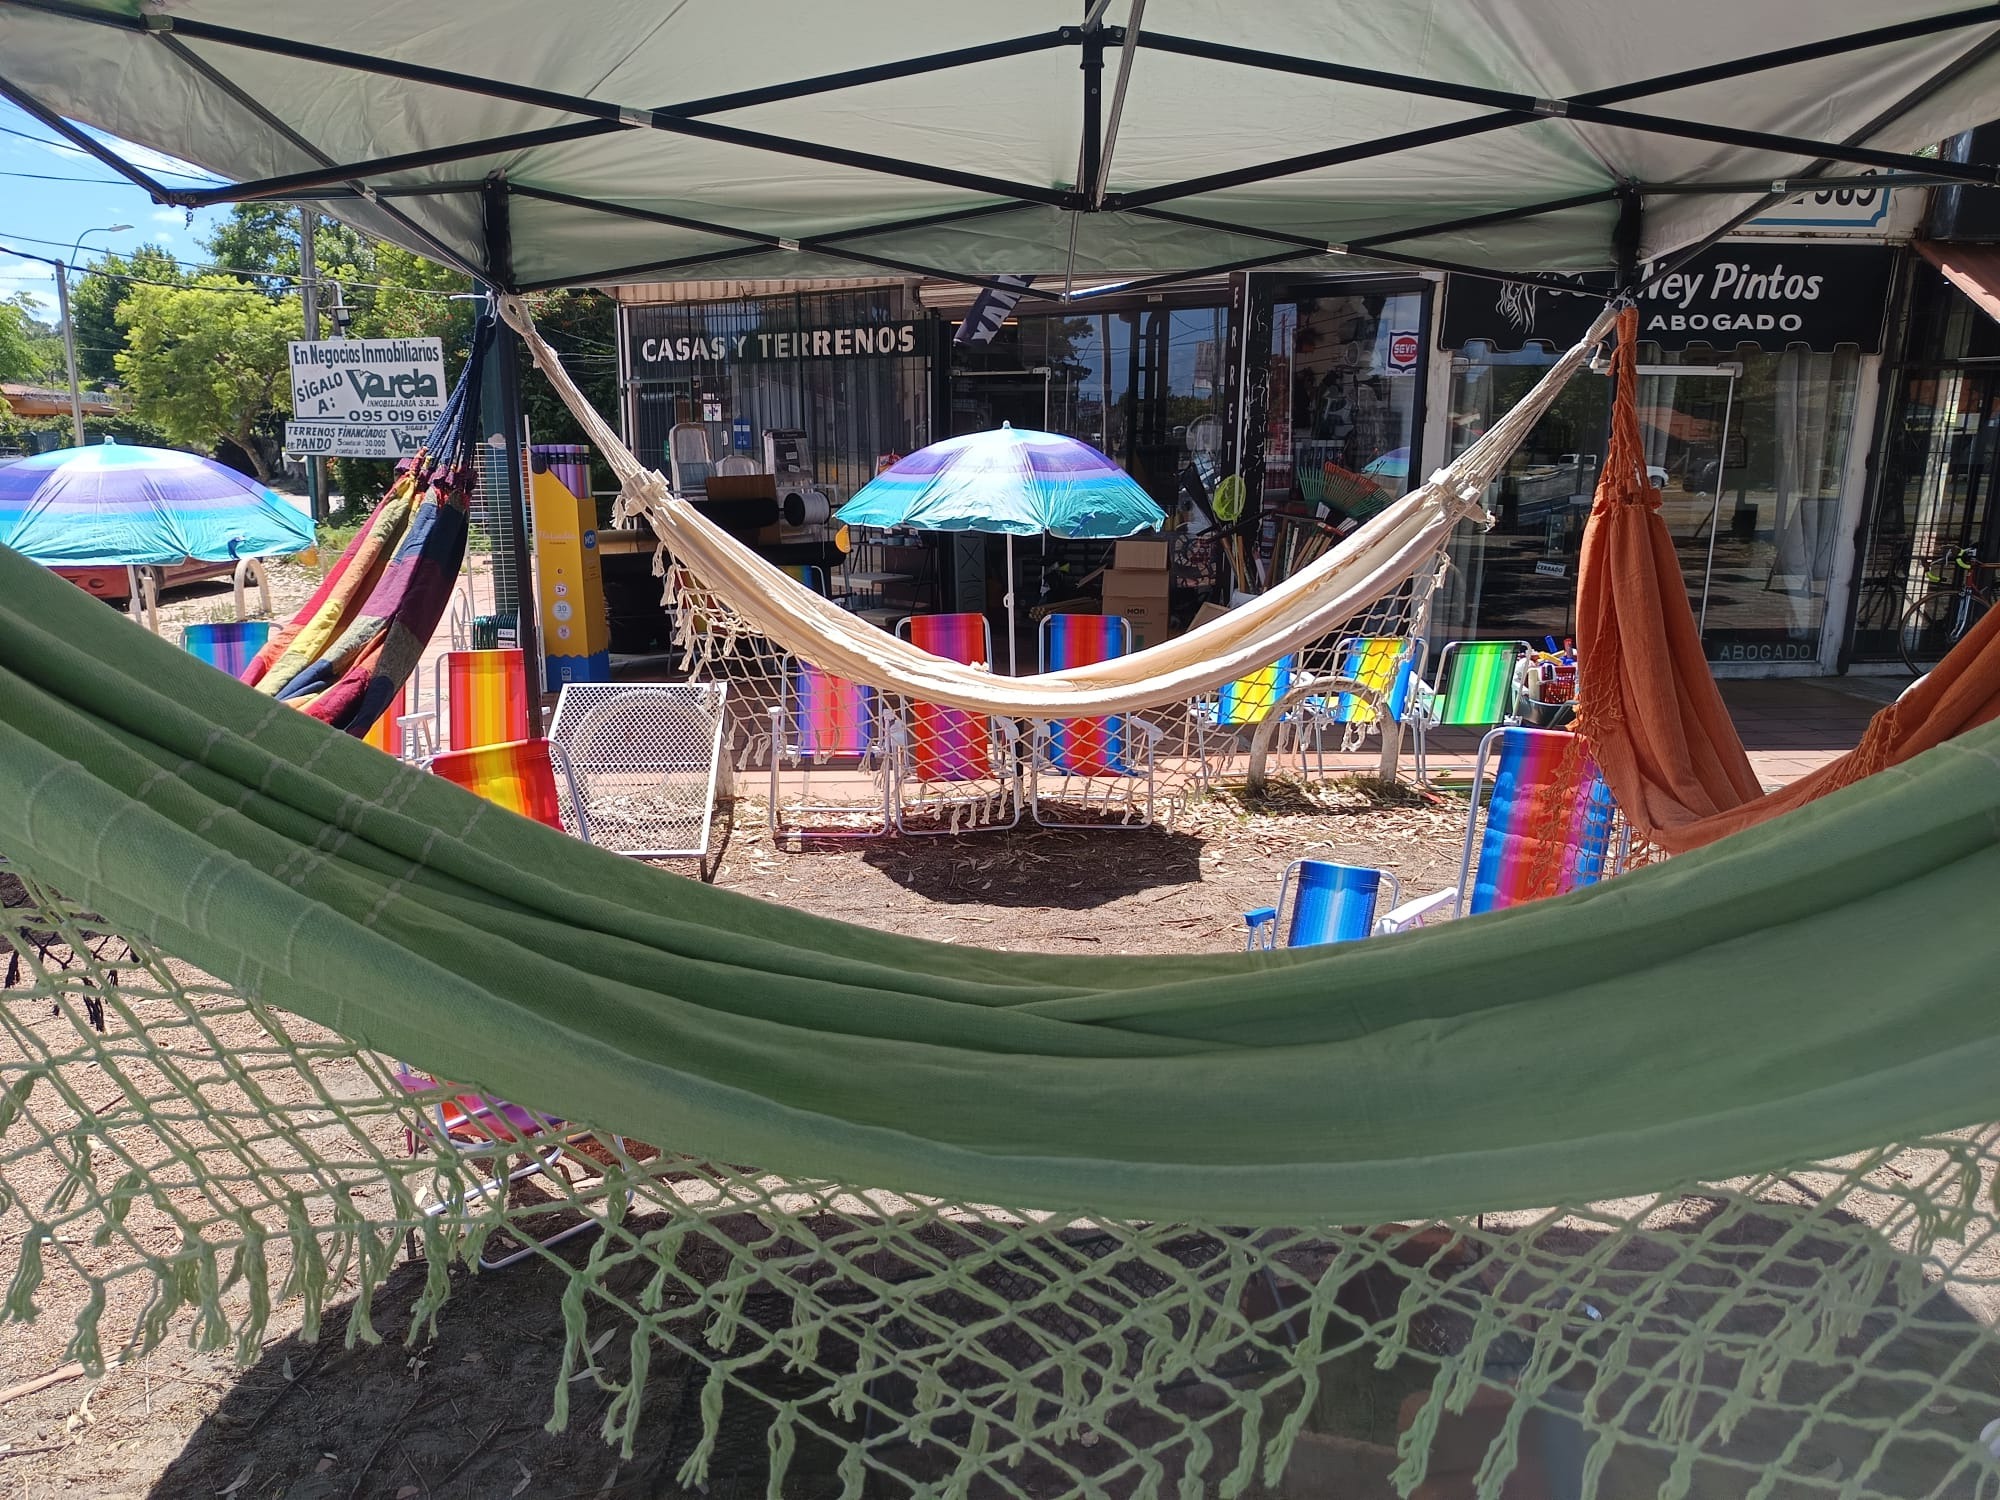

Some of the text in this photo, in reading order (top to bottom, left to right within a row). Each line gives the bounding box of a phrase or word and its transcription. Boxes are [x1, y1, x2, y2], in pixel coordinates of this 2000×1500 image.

[1637, 263, 1704, 309] Ney
[1710, 263, 1824, 300] Pintos
[1647, 314, 1803, 331] ABOGADO
[642, 325, 916, 362] CASAS Y TERRENOS
[293, 340, 439, 370] En Negocios Inmobiliarios
[345, 368, 438, 404] Varela
[367, 400, 417, 408] INMOBILIARIA
[349, 410, 442, 421] 095 019 619
[288, 426, 335, 437] TERRENOS
[296, 438, 331, 449] PANDO
[1720, 644, 1811, 660] ABOGADO
